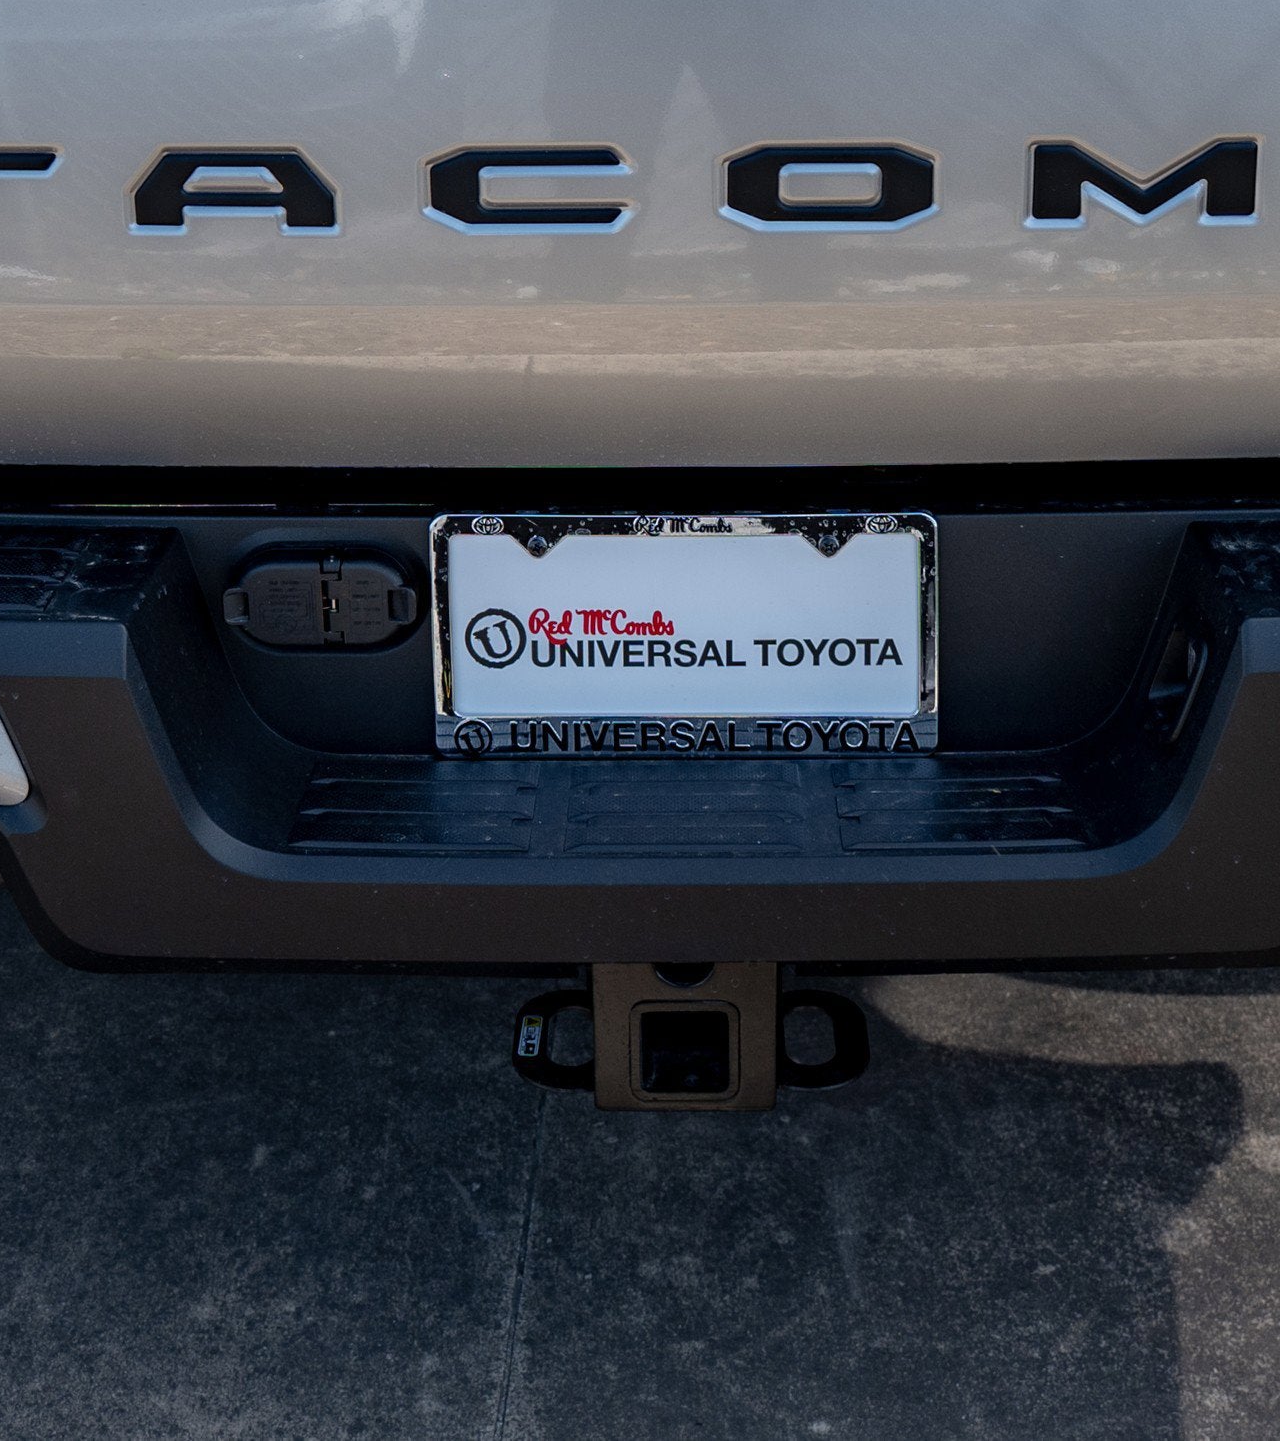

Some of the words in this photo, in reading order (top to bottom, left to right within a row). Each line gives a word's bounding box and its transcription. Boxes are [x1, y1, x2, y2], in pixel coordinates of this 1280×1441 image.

[634, 515, 665, 536] Red
[528, 608, 572, 645] Red
[575, 609, 675, 636] McCombs
[531, 639, 746, 668] UNIVERSAL
[753, 638, 904, 666] TOYOTA
[509, 720, 751, 753] UNIVERSAL
[756, 720, 919, 753] TOYOTA
